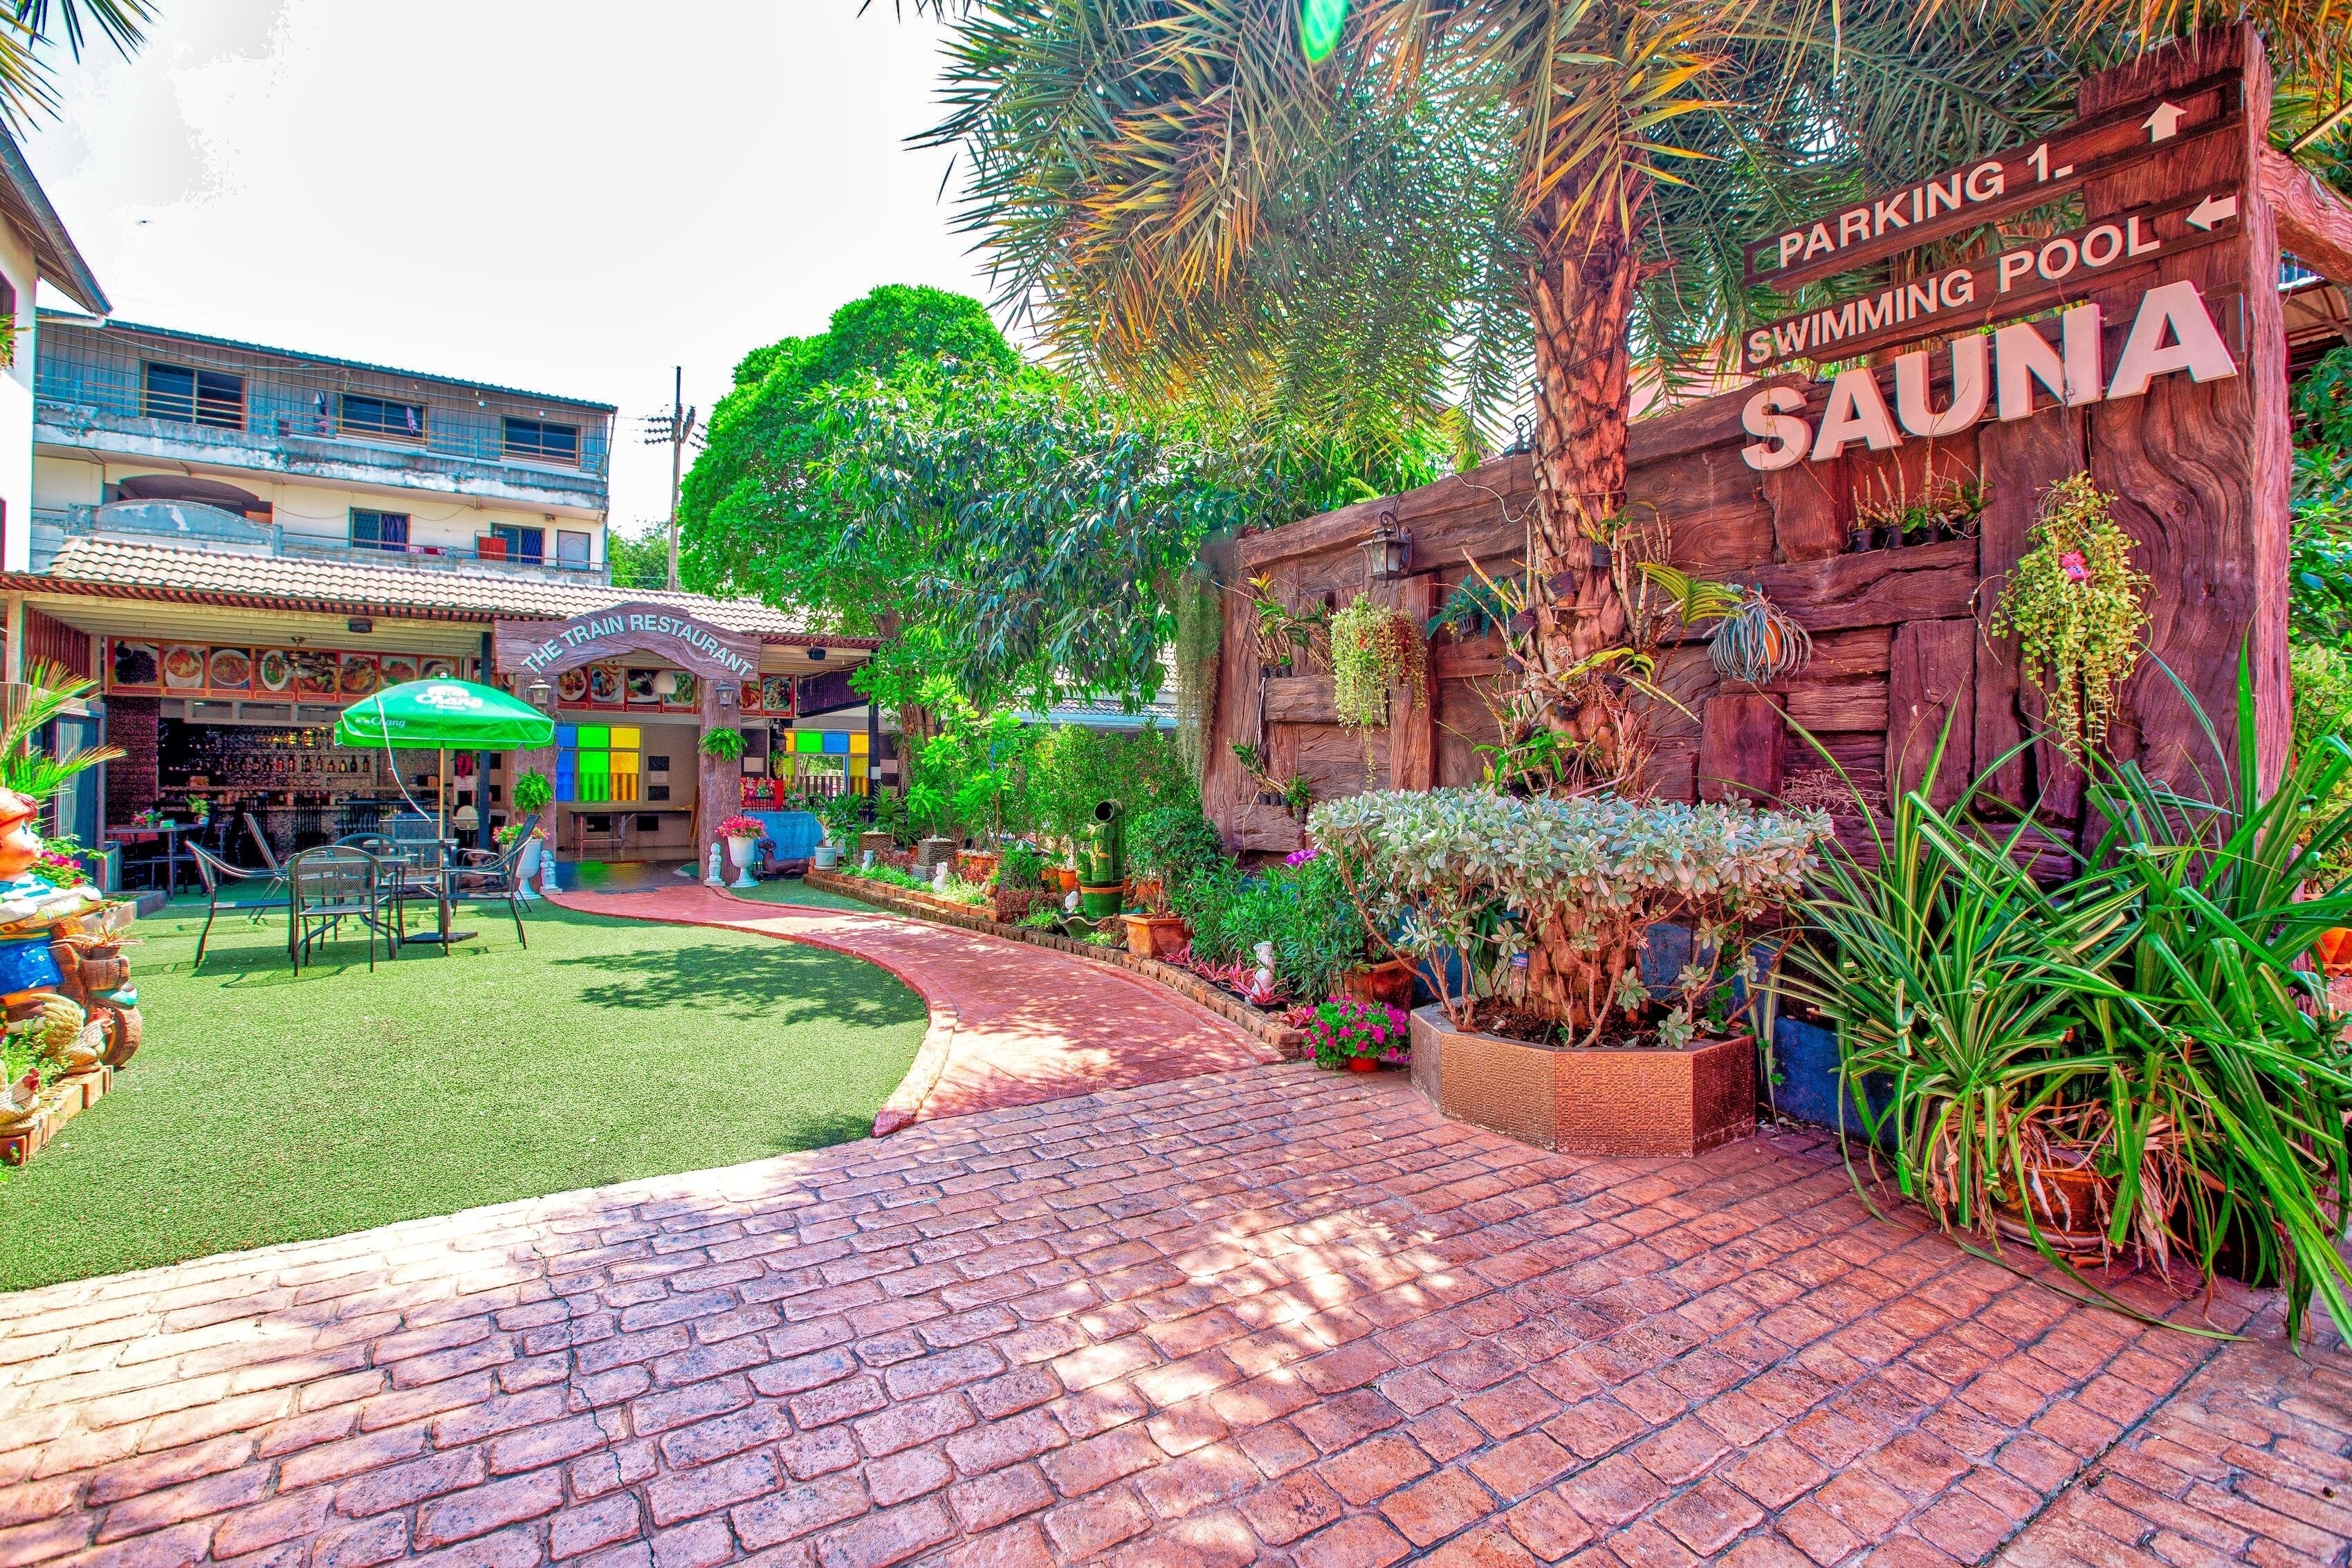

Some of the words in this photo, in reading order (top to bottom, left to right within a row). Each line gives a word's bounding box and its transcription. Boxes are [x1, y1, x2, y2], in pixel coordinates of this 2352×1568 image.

[1779, 161, 2005, 268] PARKING
[1747, 269, 1974, 365] SWIMMING
[1998, 215, 2161, 294] POOL
[1741, 279, 2239, 471] SAUNA
[521, 638, 564, 674] THE
[560, 615, 626, 649] TRAIN
[630, 614, 754, 678] RESTAURANT
[415, 694, 484, 708] Chang
